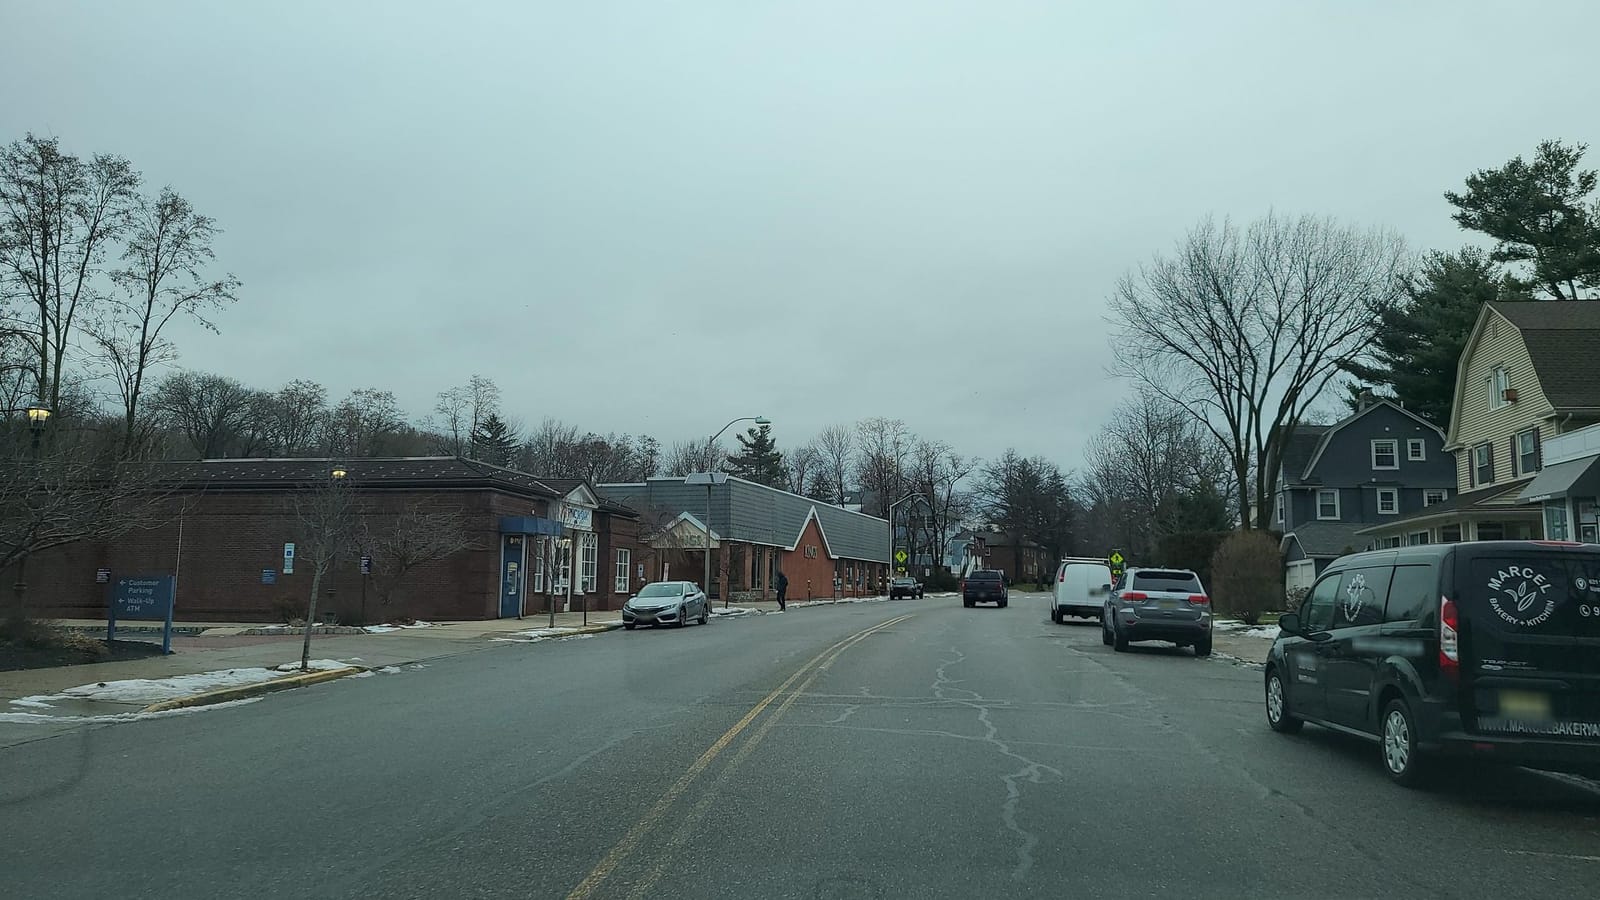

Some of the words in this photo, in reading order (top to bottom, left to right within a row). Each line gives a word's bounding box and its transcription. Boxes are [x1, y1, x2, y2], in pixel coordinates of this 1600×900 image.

[128, 587, 153, 595] Parking
[1488, 566, 1551, 594] MARCEL
[1489, 597, 1519, 625] BAKERY
[1526, 599, 1555, 627] KITCHEN
